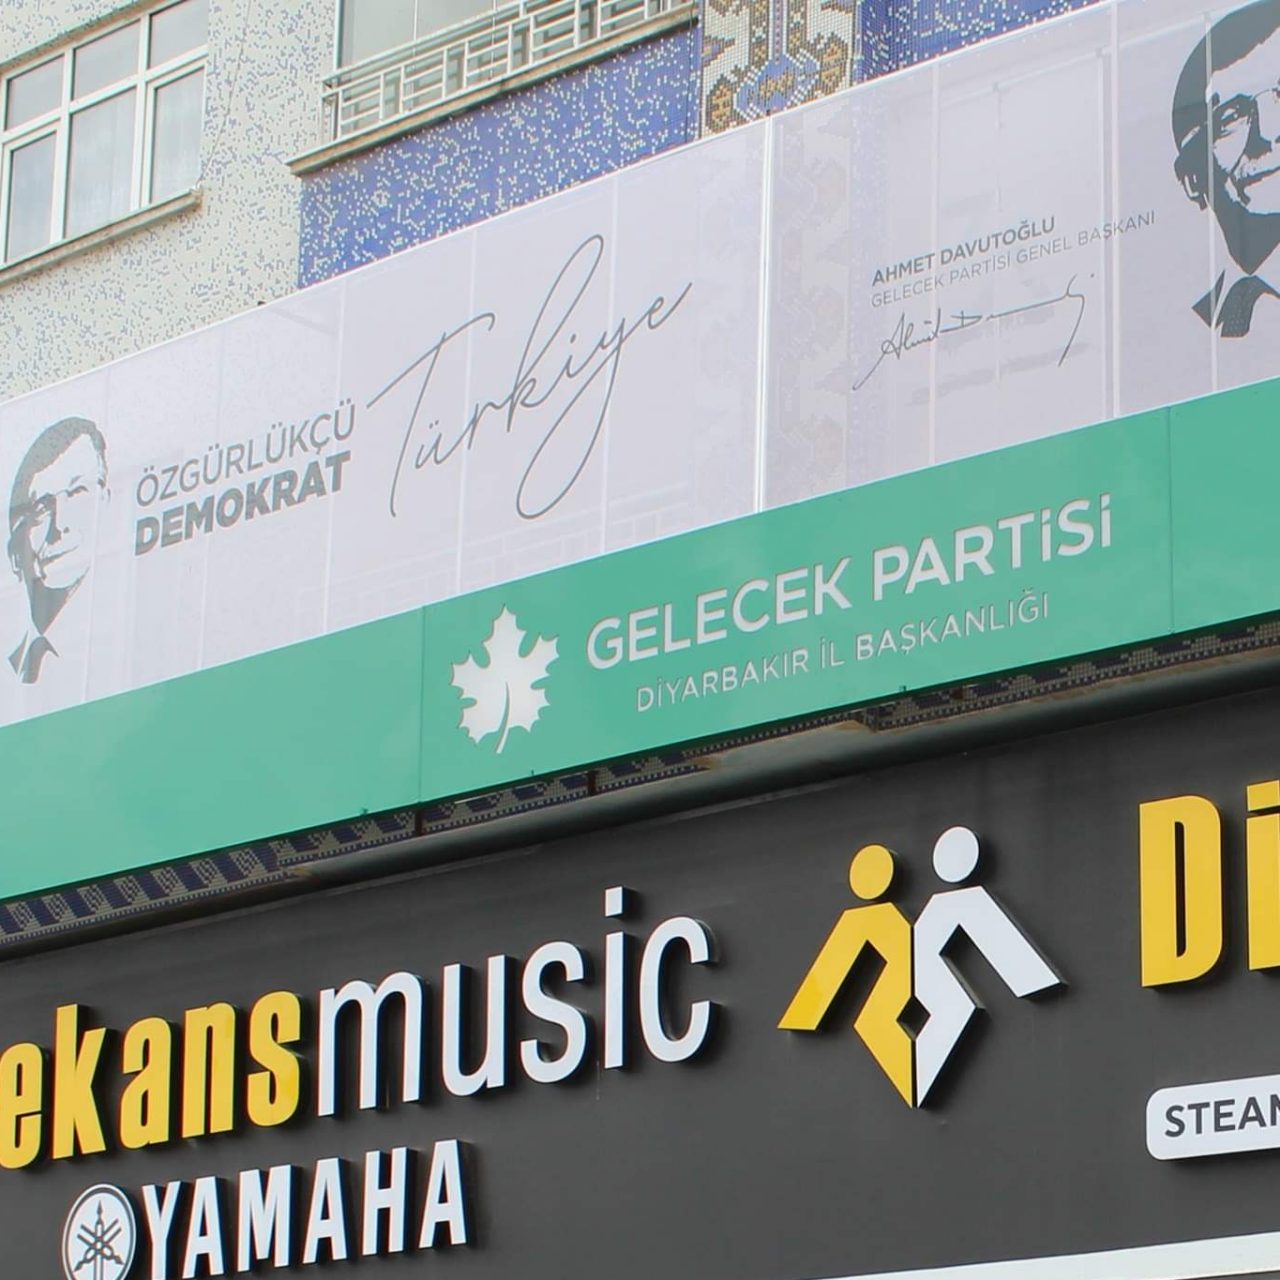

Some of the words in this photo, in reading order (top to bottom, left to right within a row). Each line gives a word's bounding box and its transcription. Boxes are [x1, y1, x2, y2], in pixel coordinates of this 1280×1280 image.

[872, 253, 935, 287] AHMET
[940, 216, 1055, 266] DAVUTOĞLU
[872, 277, 943, 308] GELECEK
[950, 254, 1011, 284] PARTİSİ
[1016, 238, 1072, 265] GENEL
[1078, 210, 1156, 246] BAŞKANI
[366, 234, 693, 519] Türkiye
[134, 451, 350, 556] DEMOKRAT
[136, 398, 356, 507] ÖZGÜRLÜKÇÜ
[586, 556, 852, 670] GELECEK
[636, 648, 810, 713] DİYARBAKIR
[819, 636, 845, 669] İL
[855, 588, 1050, 662] BAŞKANLIĞI
